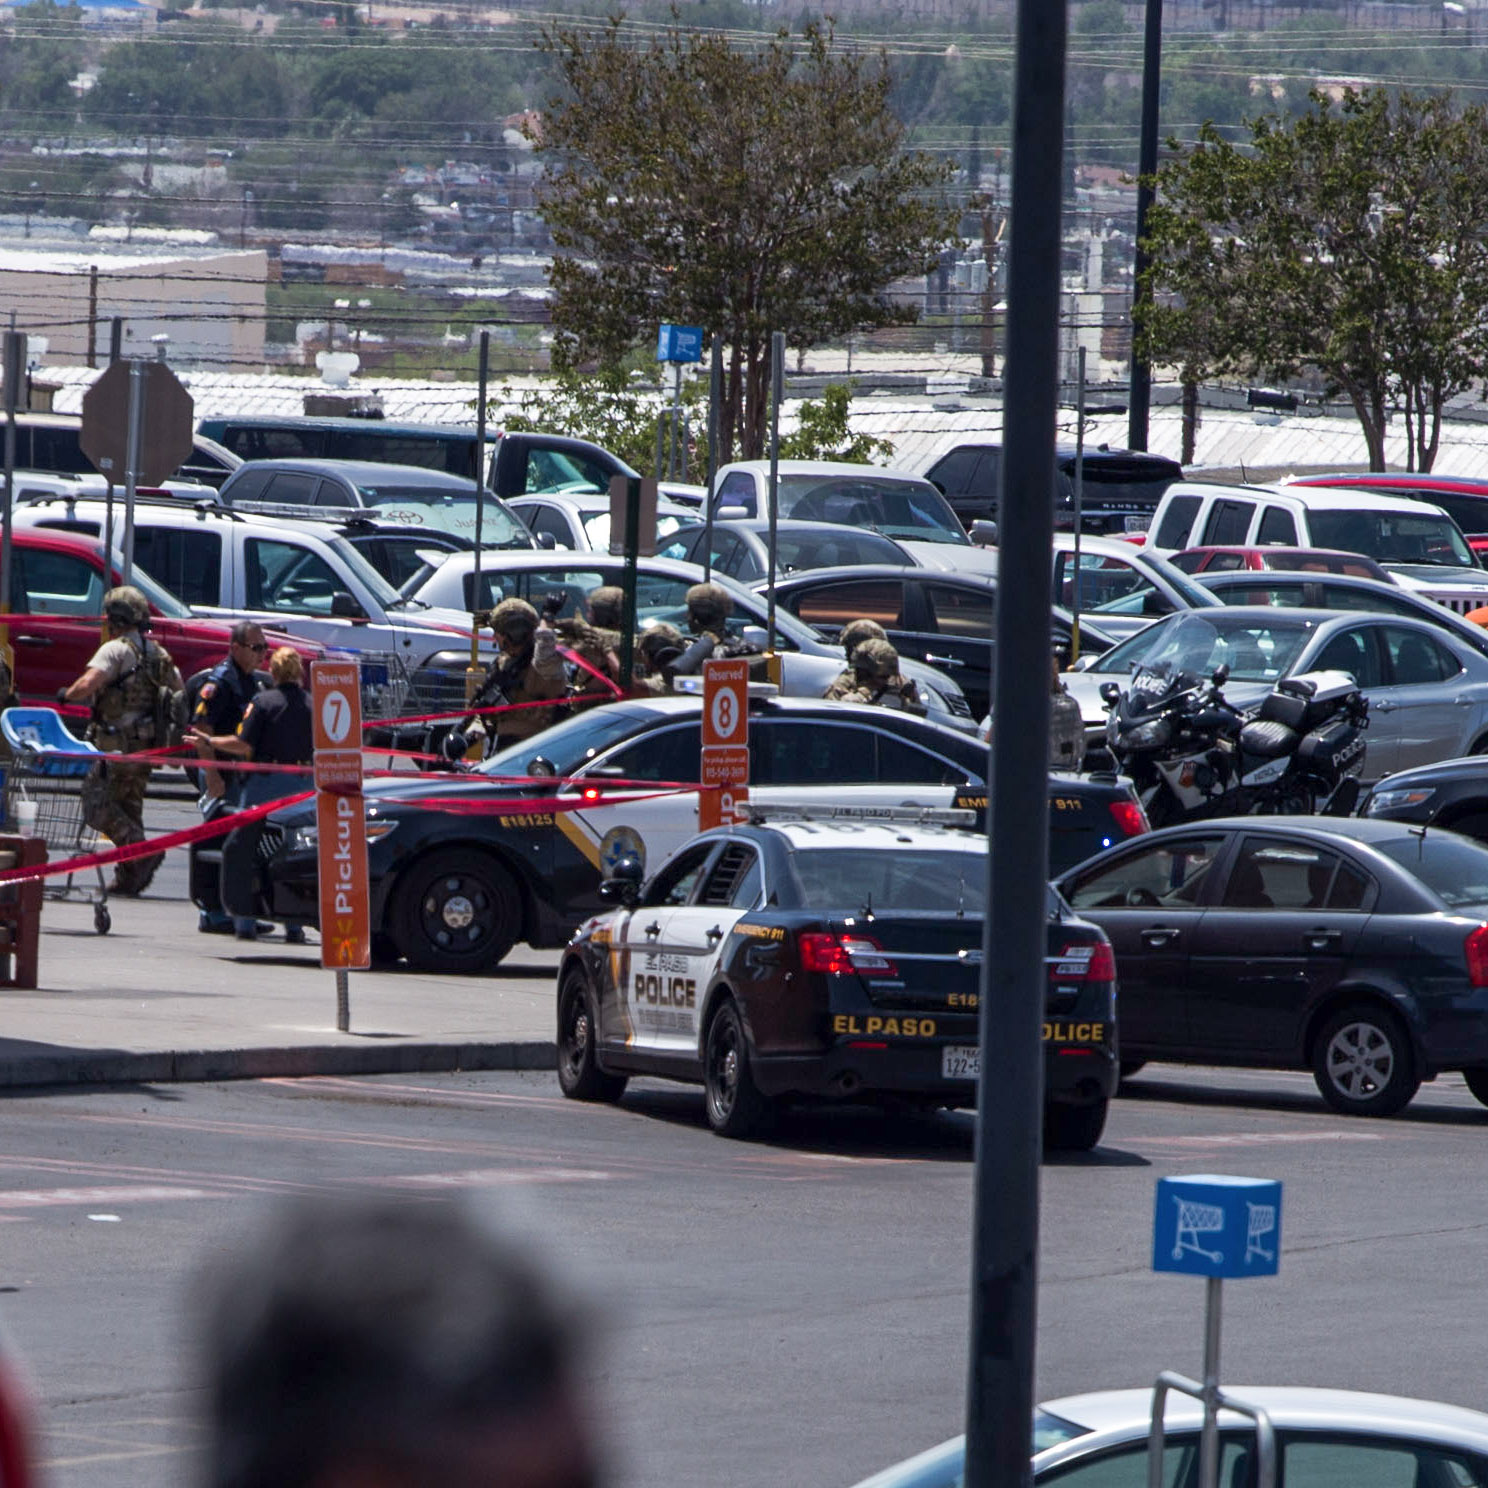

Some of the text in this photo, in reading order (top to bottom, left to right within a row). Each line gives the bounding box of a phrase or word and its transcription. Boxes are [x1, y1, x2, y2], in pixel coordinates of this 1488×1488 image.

[316, 670, 354, 686] Reserved
[708, 667, 744, 681] Reserved
[330, 700, 342, 735] 7
[718, 696, 732, 729] 8
[499, 813, 553, 828] E18125
[333, 797, 355, 914] Pickup
[635, 974, 696, 1008] POLICE
[833, 1015, 936, 1037] EL PASO
[1041, 1023, 1104, 1041] OLICE
